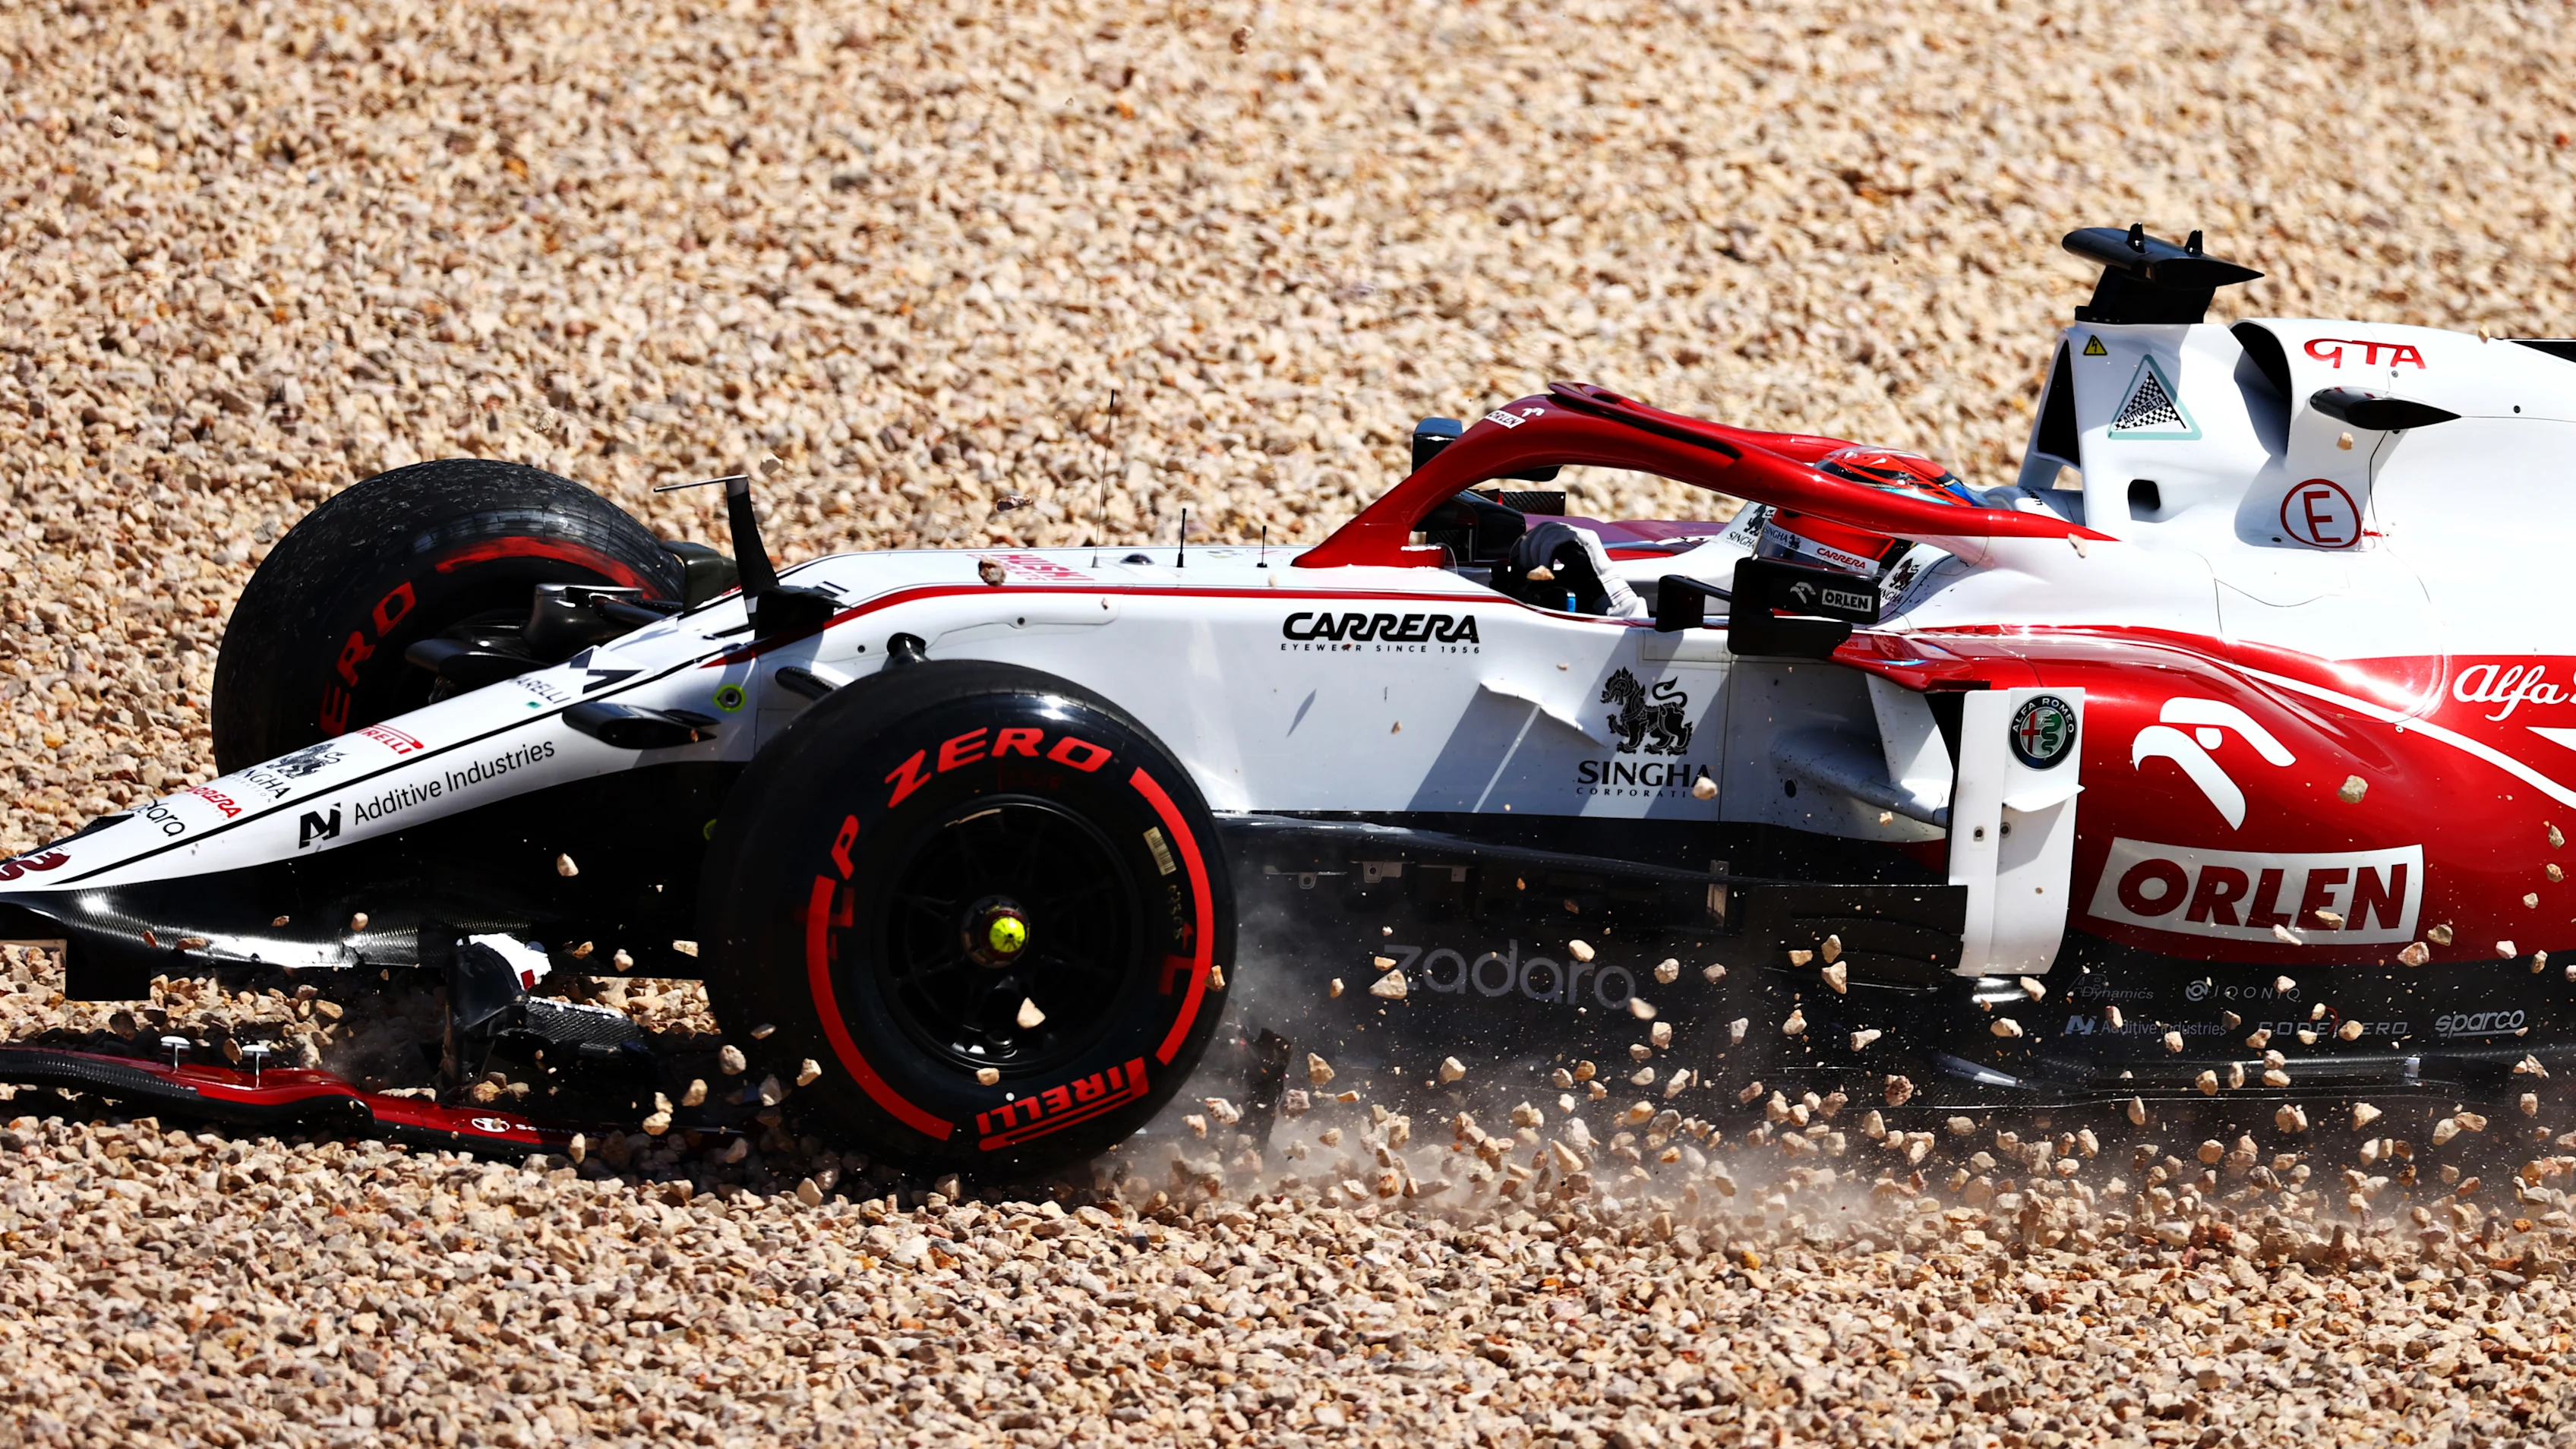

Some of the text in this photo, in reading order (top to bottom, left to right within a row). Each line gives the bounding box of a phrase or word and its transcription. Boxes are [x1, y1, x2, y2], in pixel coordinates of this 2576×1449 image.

[2303, 338, 2427, 369] GTA
[2122, 394, 2167, 426] AUTODELTA
[1765, 526, 1788, 544] SINGHA
[1817, 547, 1867, 570] CARRERA
[1824, 591, 1869, 611] ORLEN
[1282, 611, 1480, 644] CARRERA
[318, 579, 416, 739] ERO
[1280, 643, 1480, 654] EYEWER SINCE 1956
[2453, 665, 2570, 721] Alfa
[2012, 697, 2075, 734] ALFA ROMEO
[354, 775, 442, 826] Additive
[444, 740, 556, 793] Industries
[1577, 760, 1715, 787] SINGHA
[829, 726, 1113, 880] P ZERO
[1576, 787, 1713, 799] CORPORATI
[2117, 858, 2409, 932] ORLEN
[2082, 986, 2155, 1001] Dynamics
[2435, 1009, 2525, 1038] sparco
[977, 1056, 1150, 1151] PIRELLI
